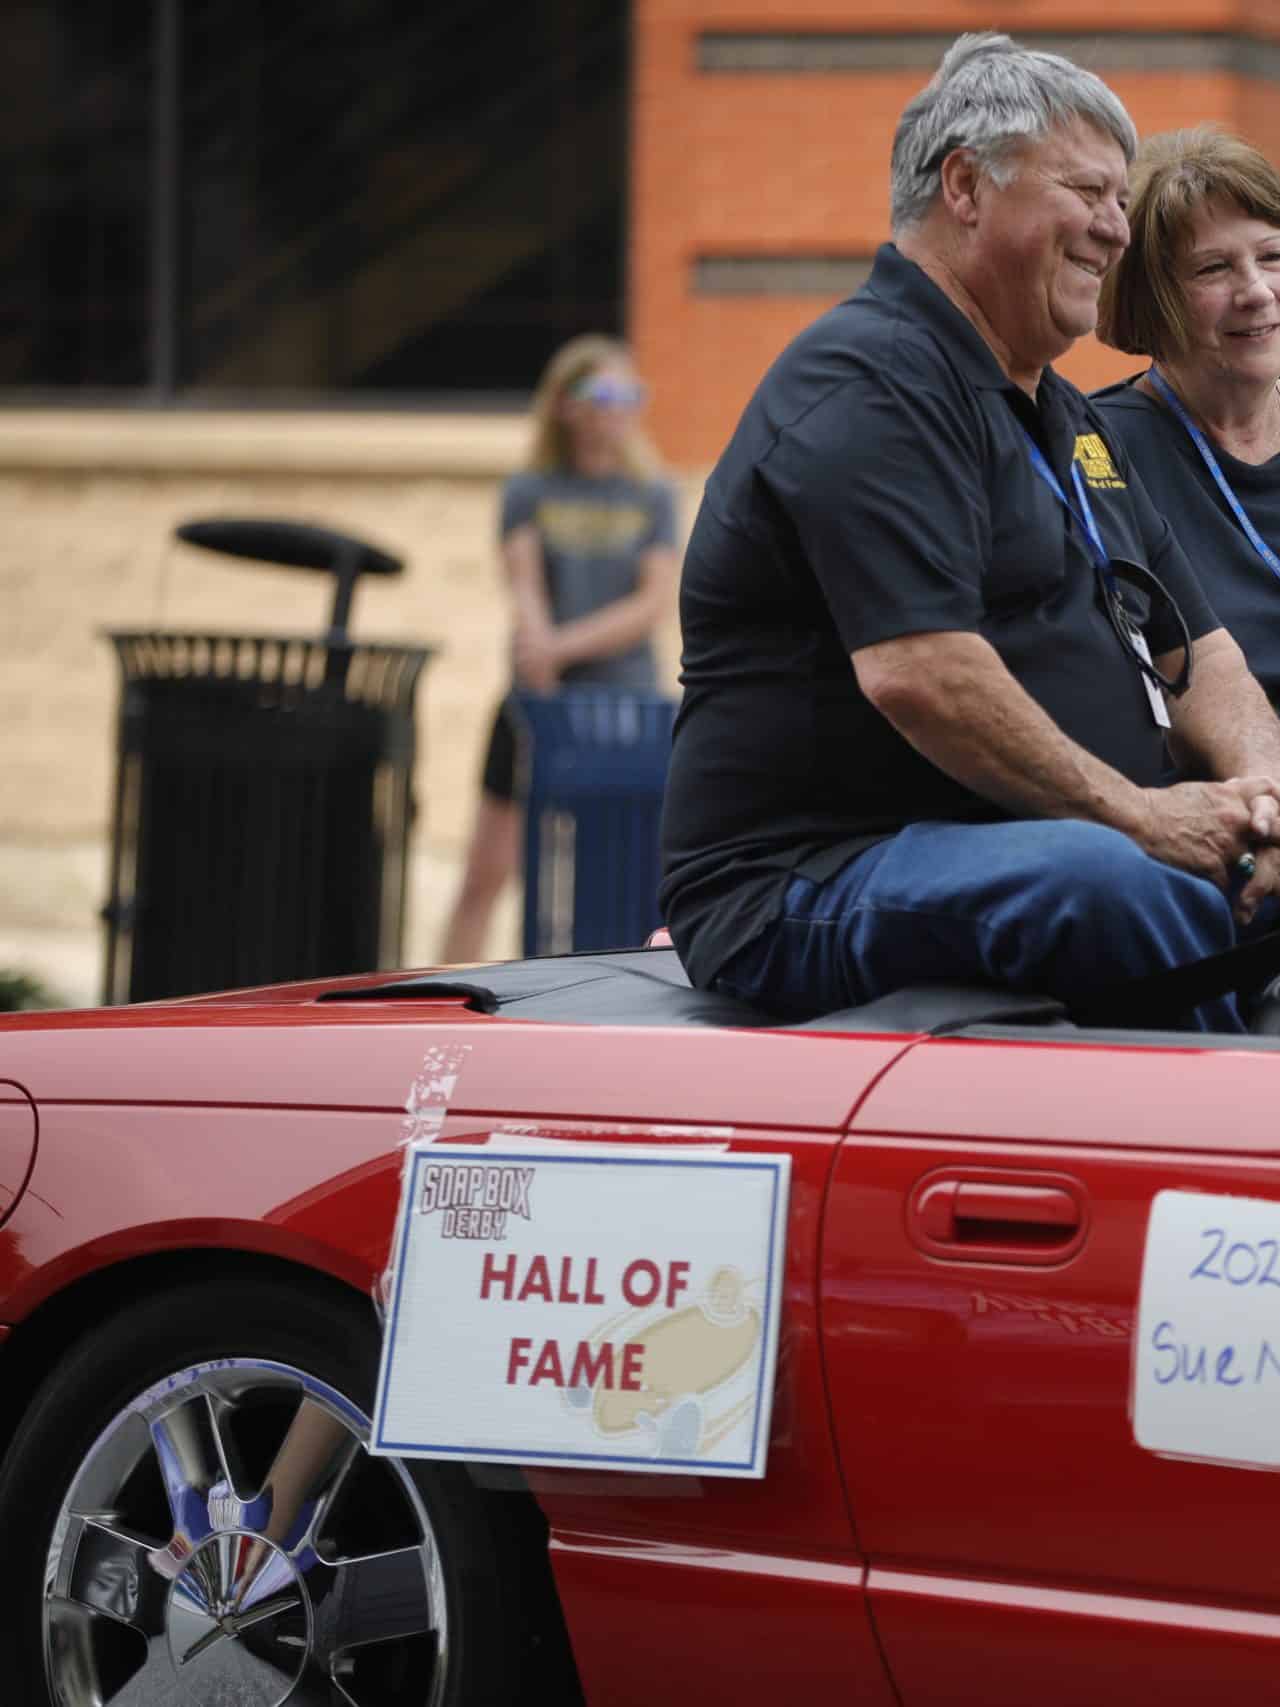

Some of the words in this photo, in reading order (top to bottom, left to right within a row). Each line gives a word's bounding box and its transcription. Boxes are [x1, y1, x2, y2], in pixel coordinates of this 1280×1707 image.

[442, 1208, 508, 1240] DERBY
[479, 1252, 605, 1305] HALL
[621, 1258, 691, 1308] OF
[506, 1337, 646, 1391] FAME
[1151, 1320, 1244, 1386] Sue
